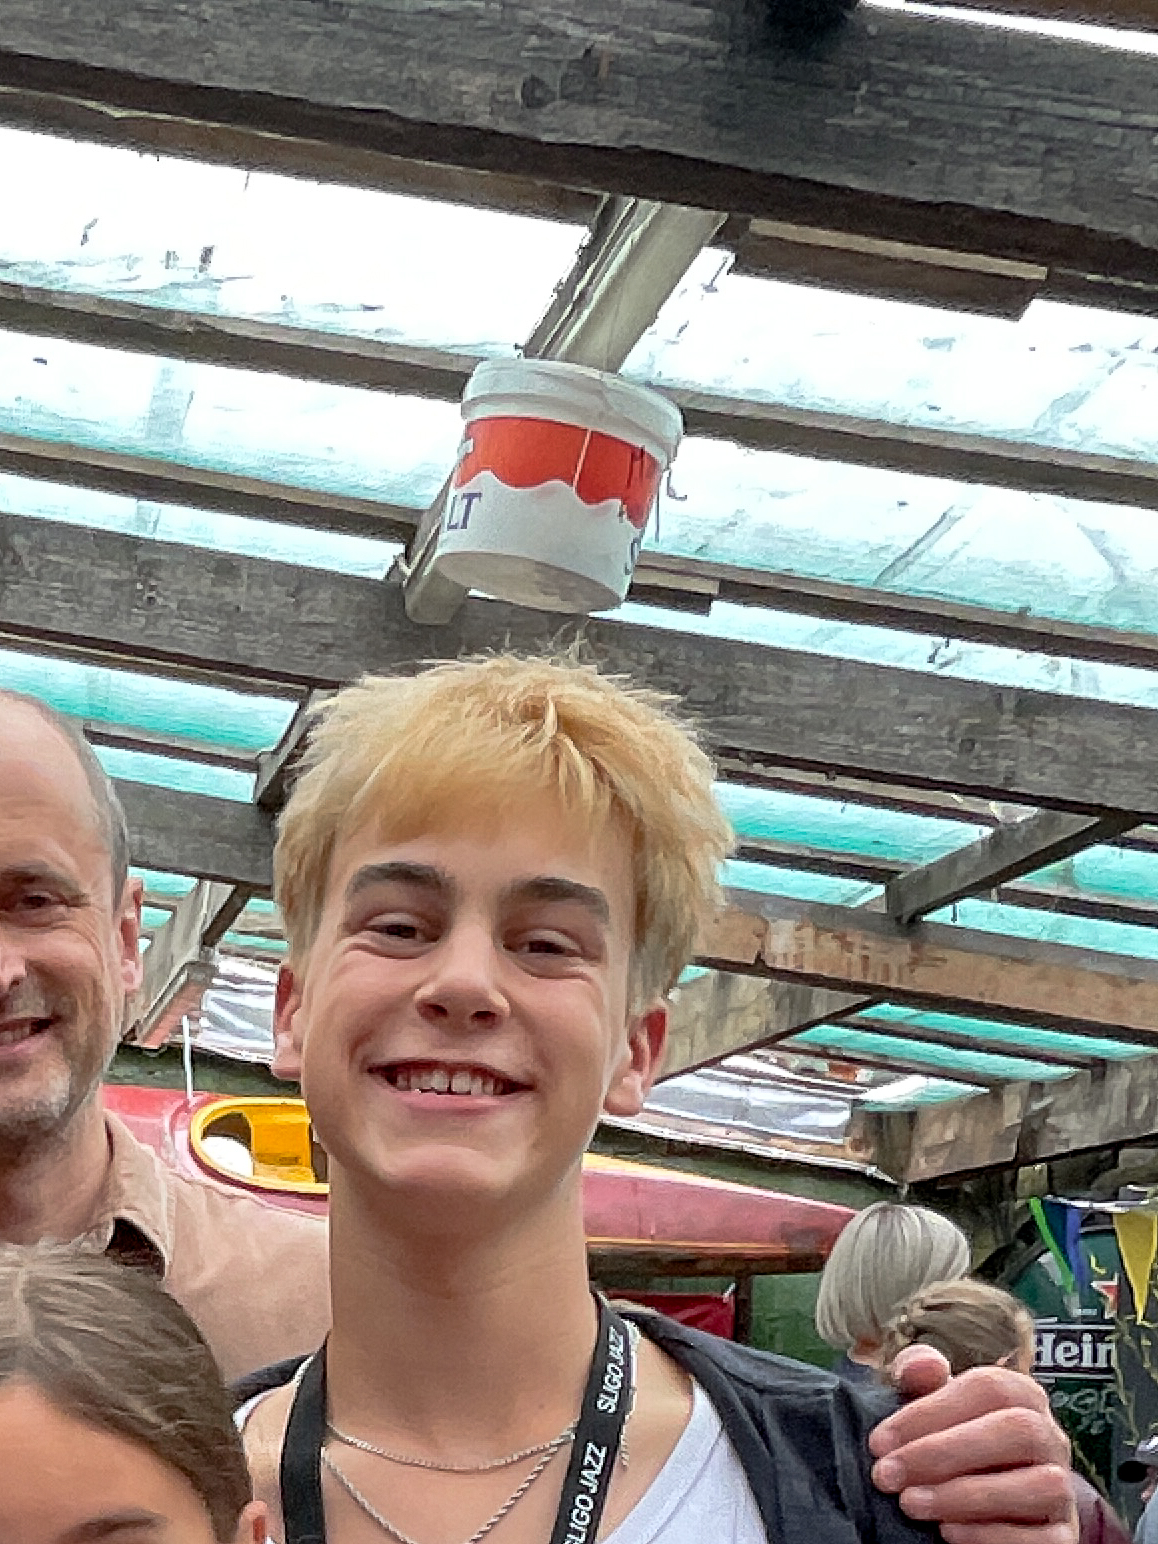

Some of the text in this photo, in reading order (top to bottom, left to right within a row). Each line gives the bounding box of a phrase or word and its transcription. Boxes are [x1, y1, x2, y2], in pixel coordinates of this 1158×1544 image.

[596, 1325, 624, 1414] SLIGO JAZZ
[578, 1440, 607, 1494] JAZZ
